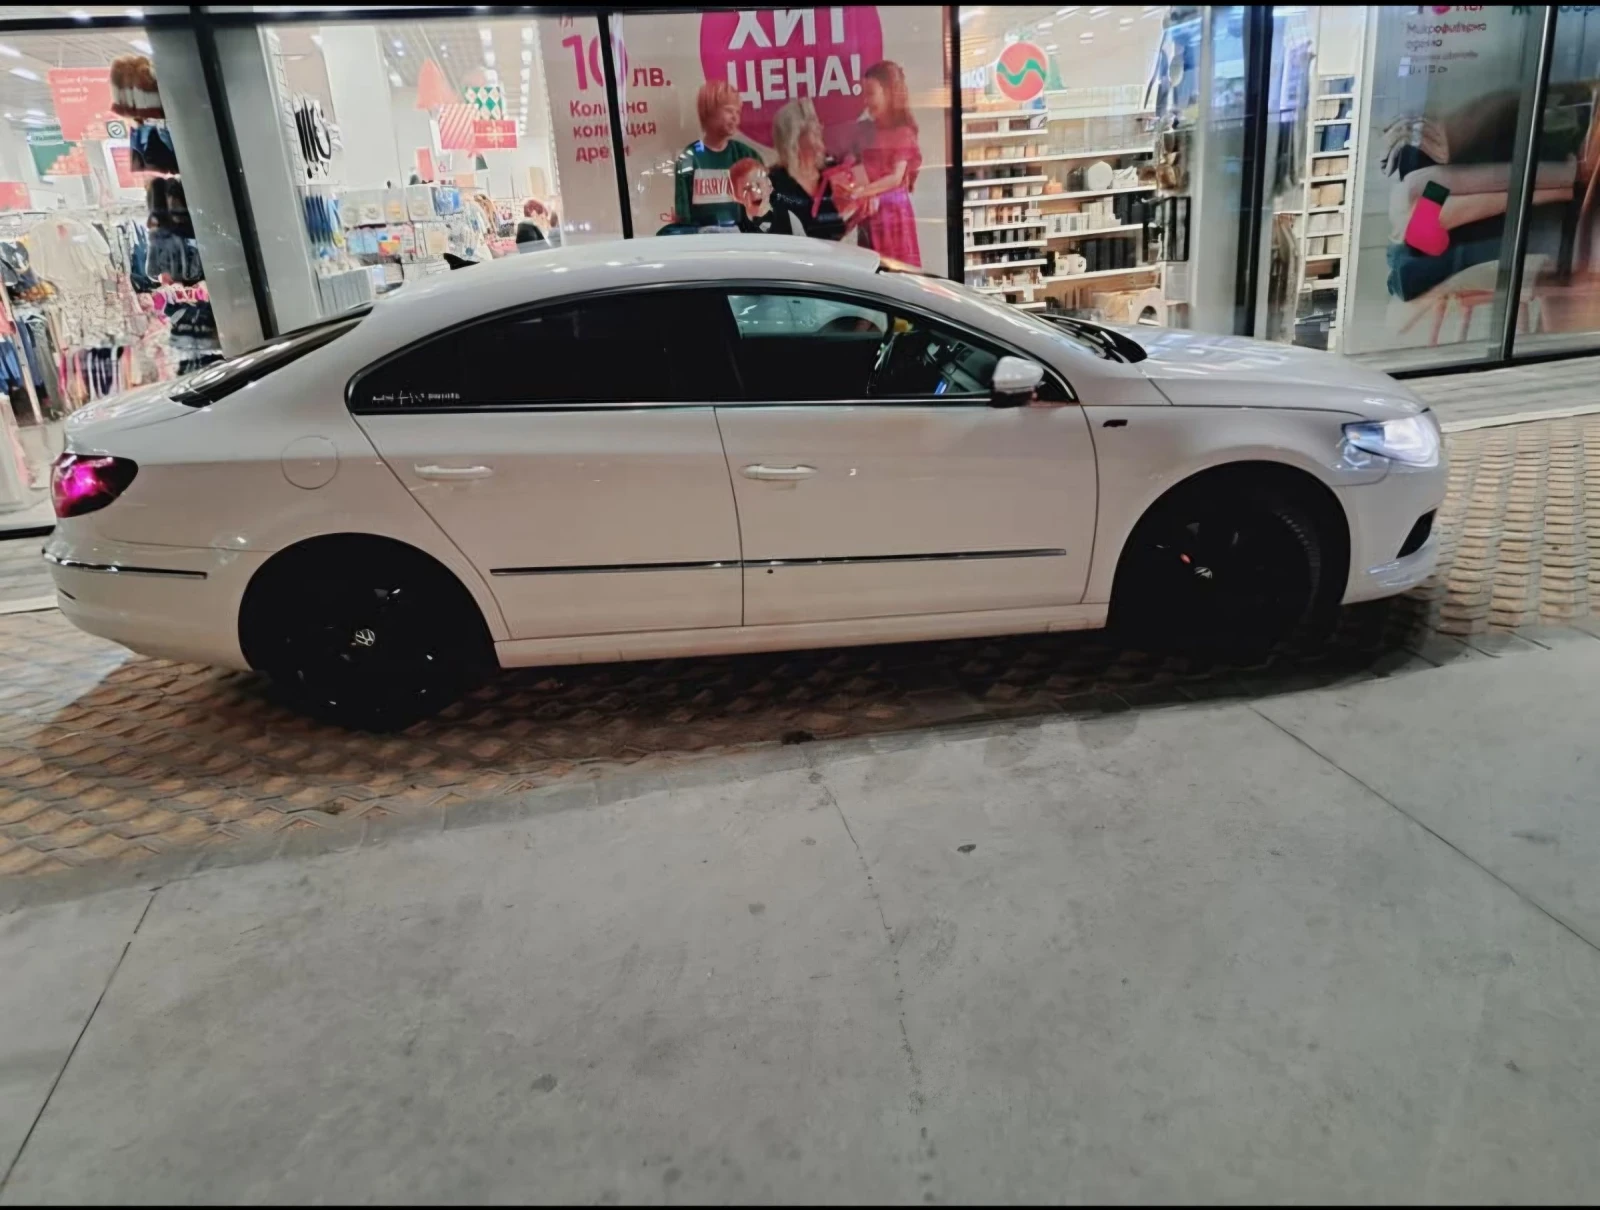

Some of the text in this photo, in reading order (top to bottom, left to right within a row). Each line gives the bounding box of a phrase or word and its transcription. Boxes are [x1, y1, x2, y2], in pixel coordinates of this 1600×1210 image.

[562, 34, 628, 90] 10
[727, 54, 862, 109] ЦЕНА!
[570, 100, 648, 118] Колна
[573, 121, 657, 138] колция
